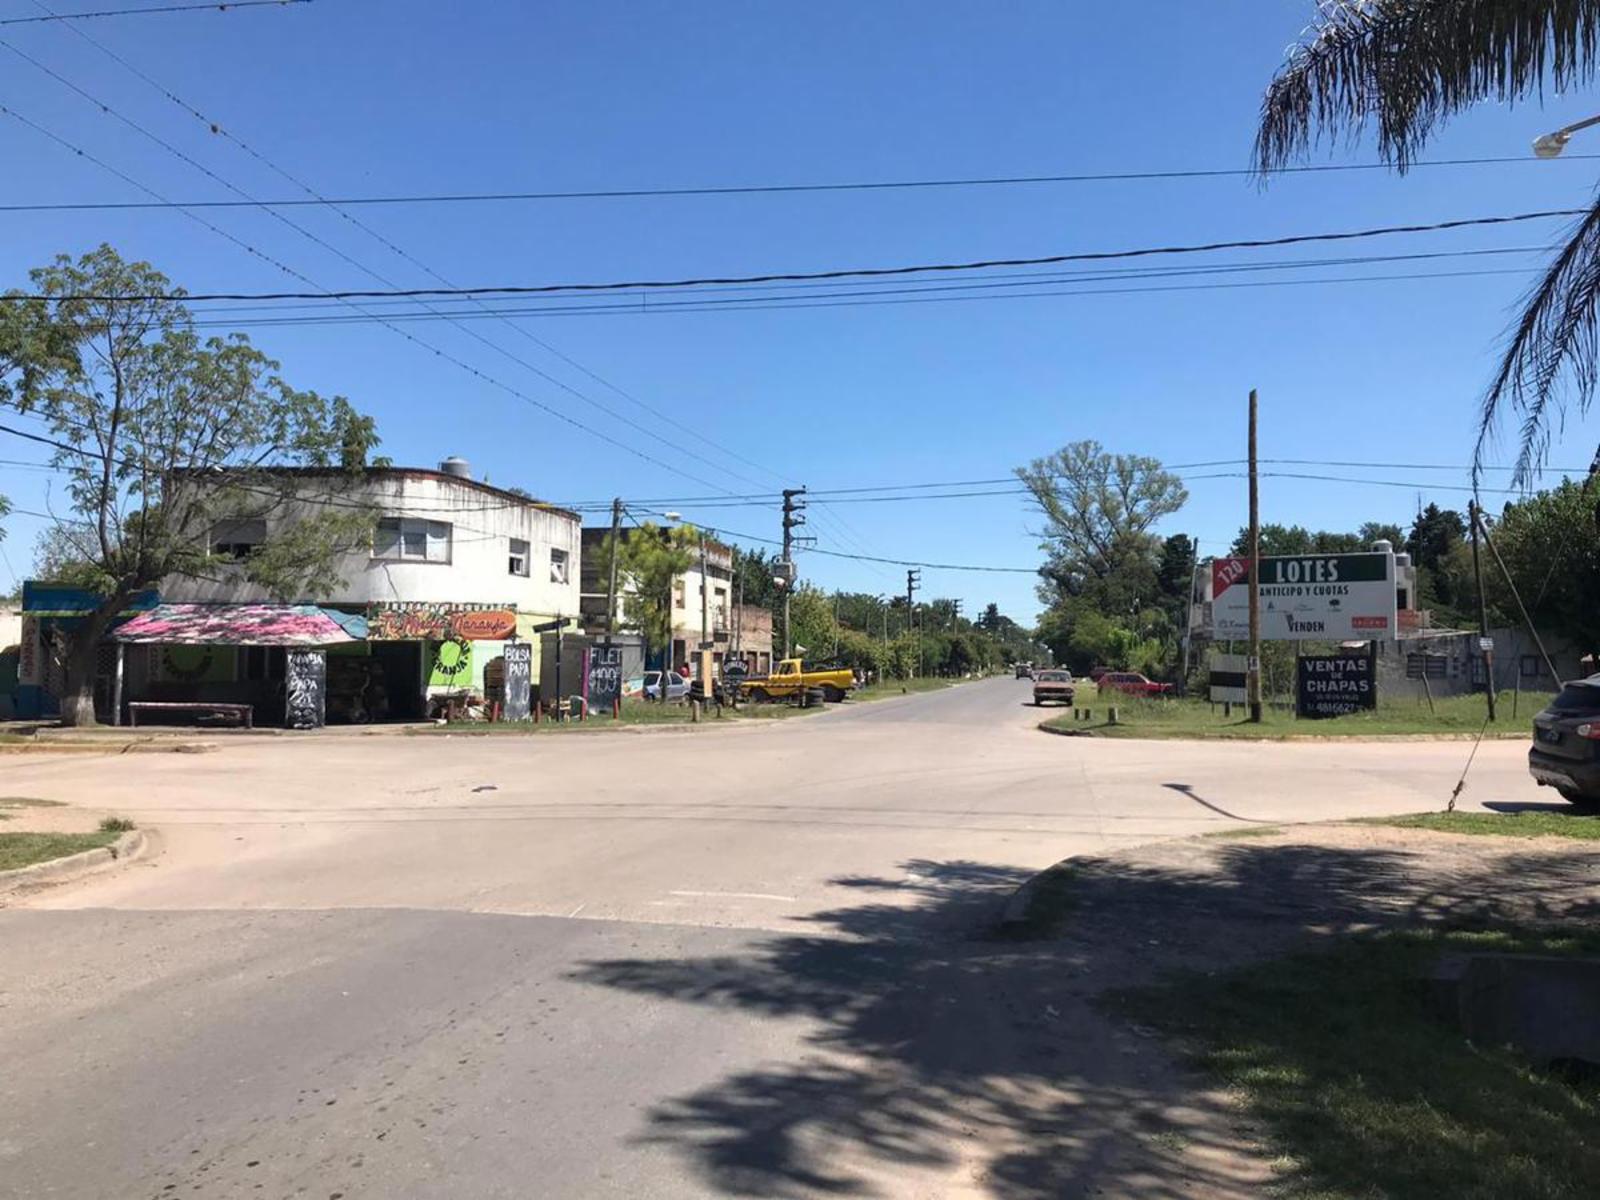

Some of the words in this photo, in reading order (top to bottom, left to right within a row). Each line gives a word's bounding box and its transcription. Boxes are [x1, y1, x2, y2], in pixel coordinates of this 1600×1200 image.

[1217, 560, 1244, 584] 120
[1276, 560, 1339, 583] LOTES
[1260, 586, 1303, 597] ANTICIPO
[1305, 586, 1311, 596] Y
[1313, 585, 1349, 596] CUOTAS
[590, 647, 621, 665] FILET
[509, 662, 529, 677] PAPA
[1305, 659, 1368, 672] VENTAS
[1307, 679, 1369, 692] CHAPAS
